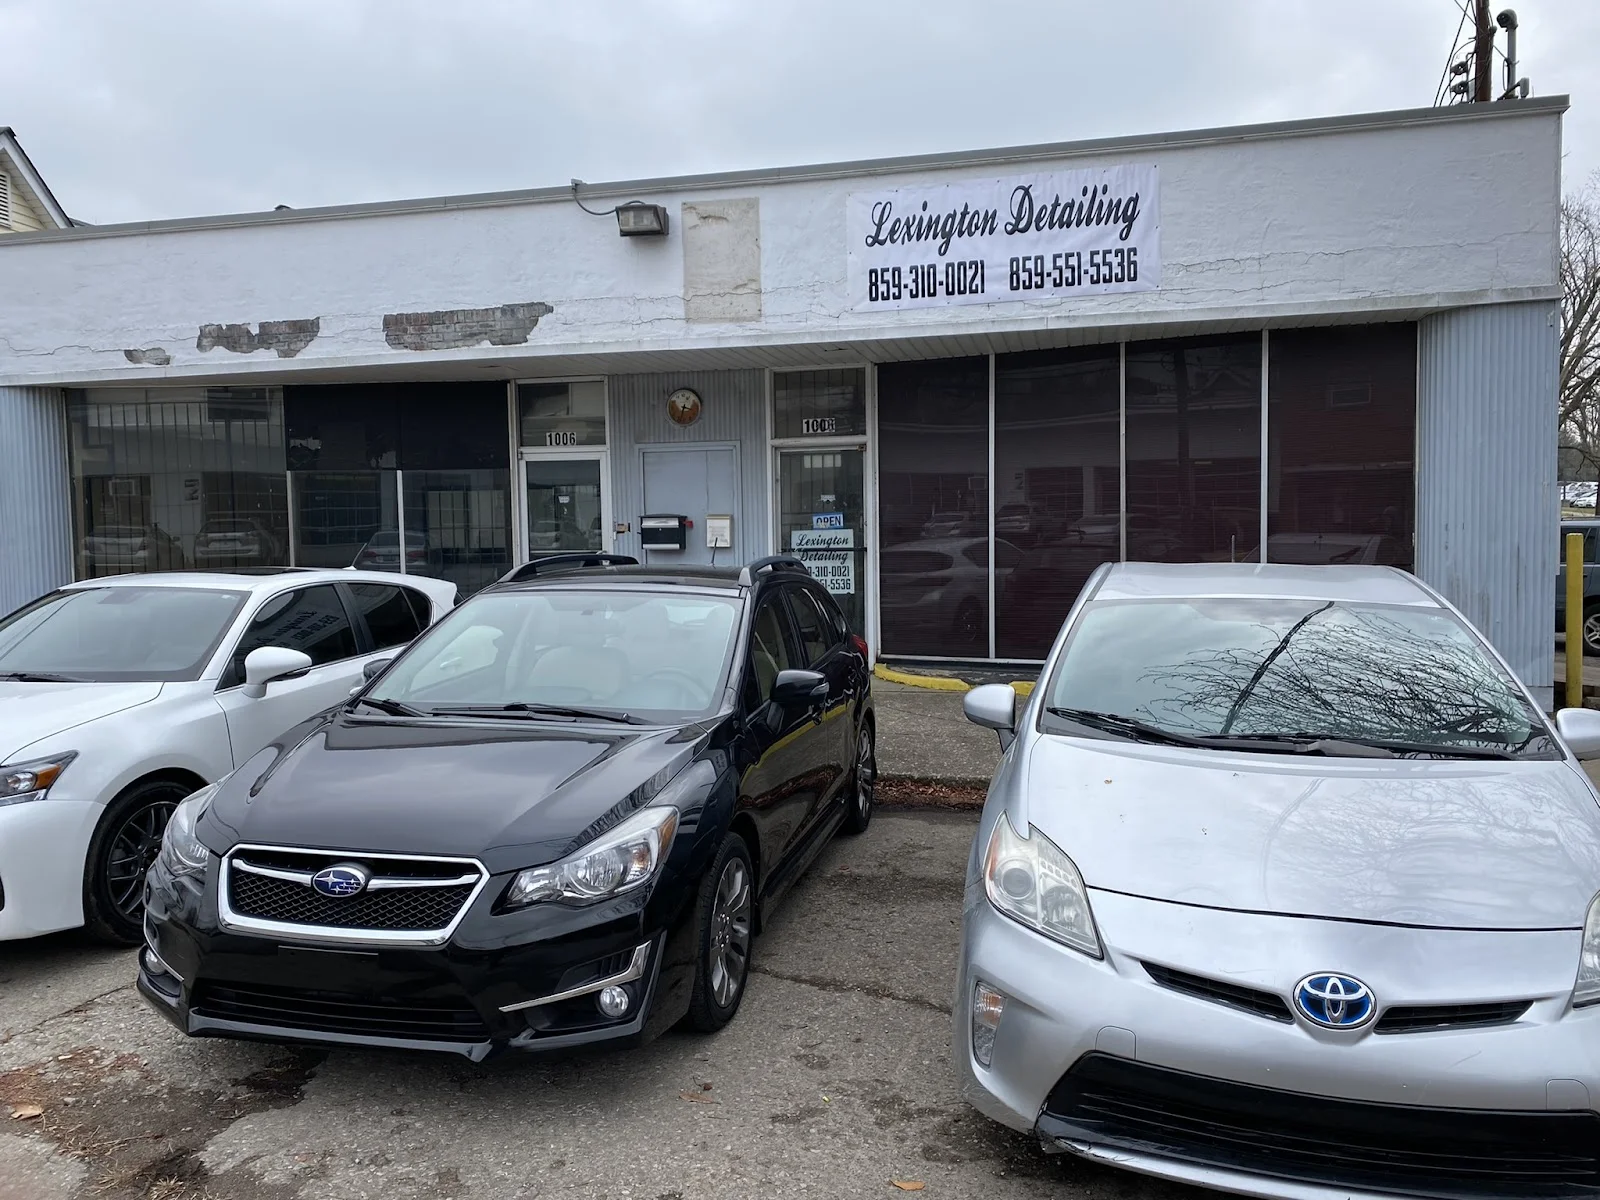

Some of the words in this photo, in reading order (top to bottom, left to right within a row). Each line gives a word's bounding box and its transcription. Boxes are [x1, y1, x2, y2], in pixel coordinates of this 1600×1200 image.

[865, 200, 999, 256] Lexington
[1005, 184, 1140, 241] Detailing
[868, 259, 985, 302] 859-310-0021
[1009, 247, 1138, 291] 859-551-5536
[547, 432, 576, 446] 1006
[816, 516, 841, 527] OPEN
[796, 533, 849, 548] Lexington
[799, 549, 848, 565] Detailing
